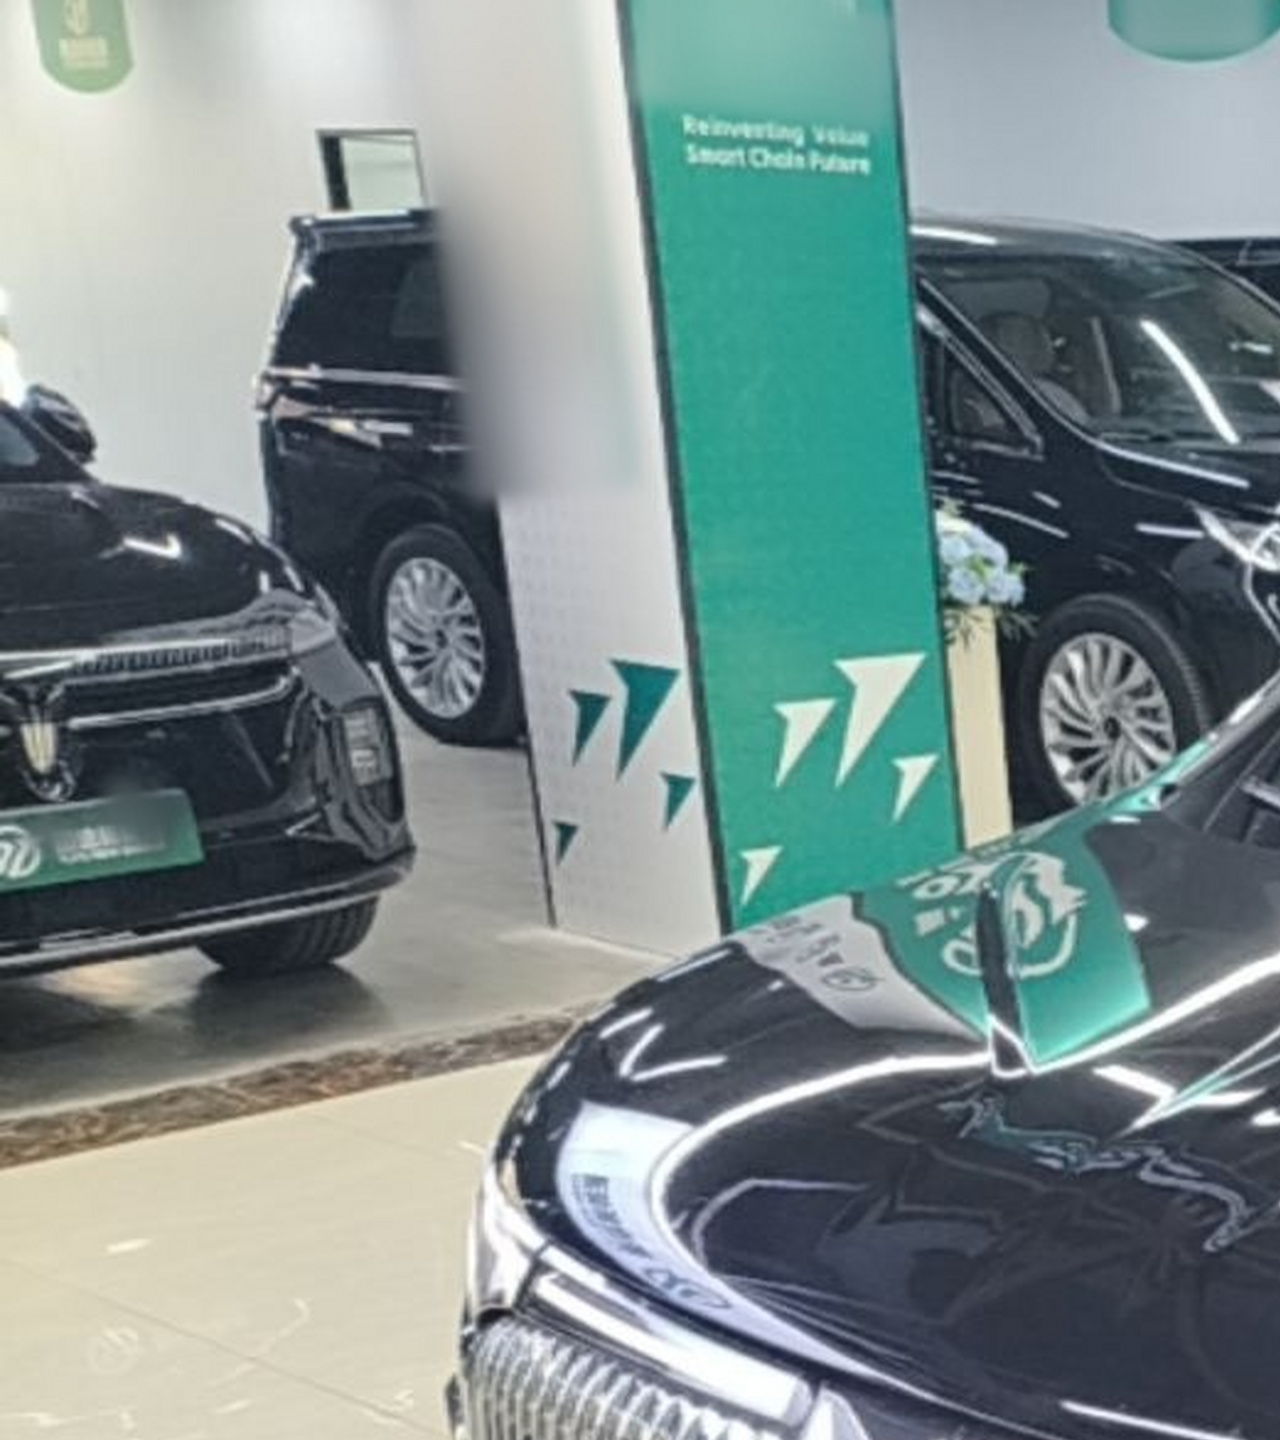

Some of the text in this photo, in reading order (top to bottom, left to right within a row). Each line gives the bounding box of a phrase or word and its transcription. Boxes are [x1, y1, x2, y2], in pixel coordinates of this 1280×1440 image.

[686, 144, 870, 175] Smart Chain Future
